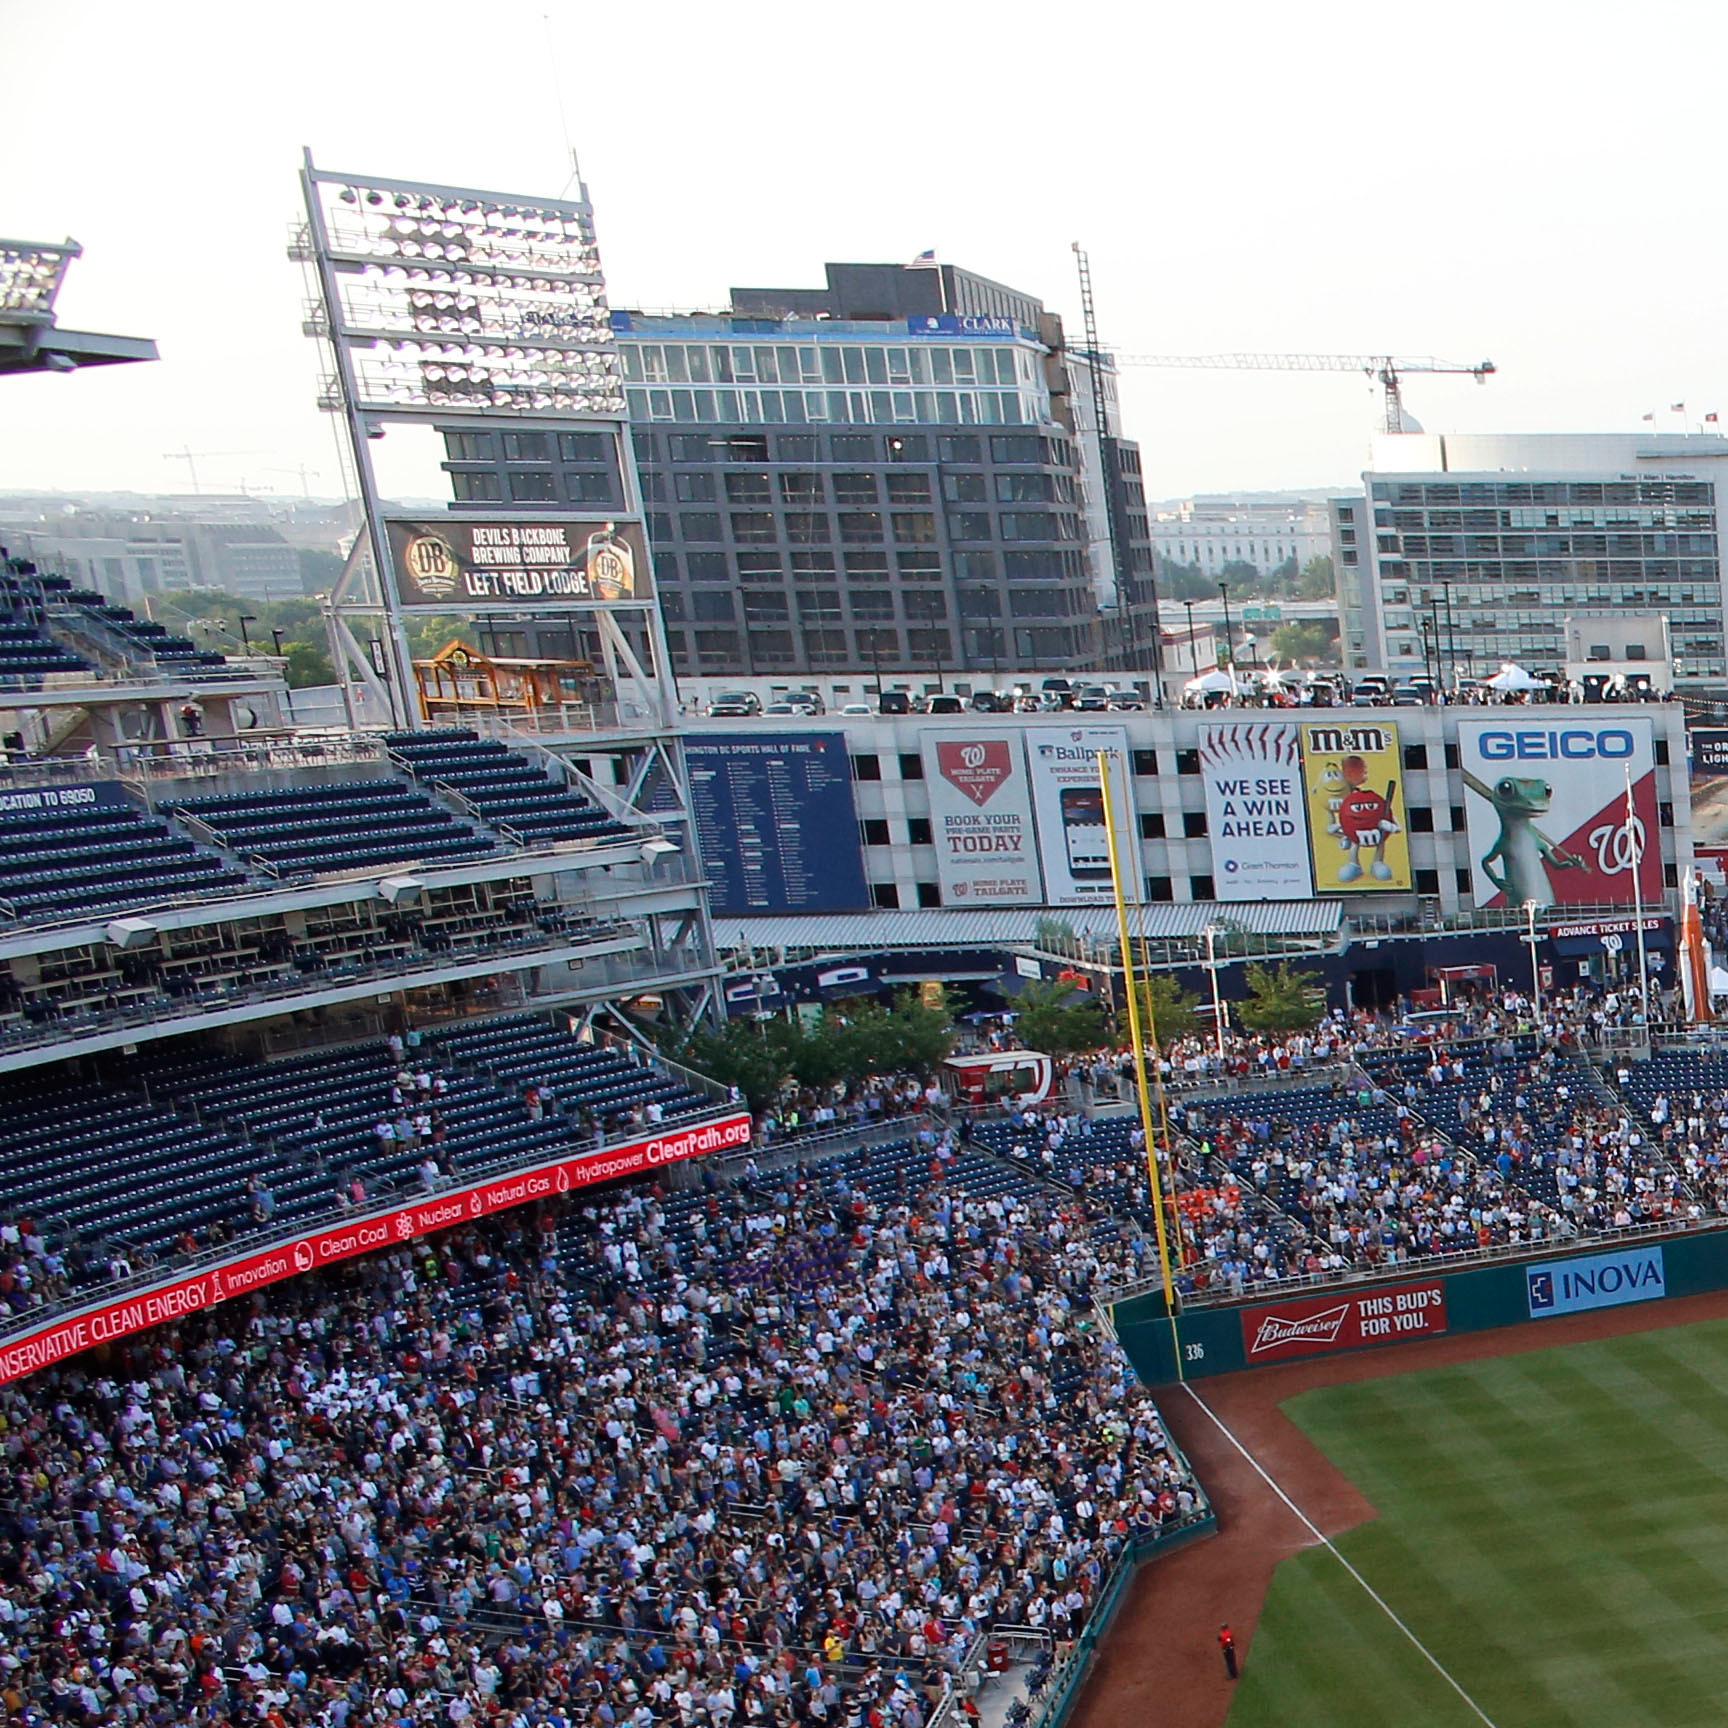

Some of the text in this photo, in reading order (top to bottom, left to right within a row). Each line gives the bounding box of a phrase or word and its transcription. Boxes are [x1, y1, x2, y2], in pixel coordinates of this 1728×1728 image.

[963, 319, 1010, 330] CLARK
[473, 528, 567, 545] DEVILS BACKBONE
[473, 546, 570, 564] BREWING COMPANY
[464, 571, 501, 595] LEFT
[503, 571, 542, 595] FIELD
[544, 571, 589, 594] LODGE
[1479, 730, 1635, 761] GEICO
[1216, 779, 1292, 796] WE SEE
[945, 814, 1021, 826] BOOK YOUR
[1223, 800, 1290, 817] A WIN
[1222, 820, 1295, 838] AHEAD
[947, 835, 1023, 853] TODAY
[975, 886, 1028, 896] TAILGATE
[1557, 919, 1660, 937] ADVANCE TICKET SLES
[647, 1117, 750, 1164] ClearPath.org
[576, 1151, 644, 1182] Hydropower
[487, 1176, 550, 1206] Natural Gas
[418, 1203, 463, 1227] Nuclear
[319, 1223, 388, 1257] Clean Coal
[1563, 1260, 1663, 1299] INOVA
[91, 1303, 143, 1341] CLEAN
[146, 1283, 207, 1323] ENERGY
[1357, 1289, 1442, 1317] THIS BUD'S
[1257, 1318, 1340, 1343] Budweiser
[1360, 1312, 1429, 1337] FOR YOU.
[1186, 1343, 1204, 1361] 336
